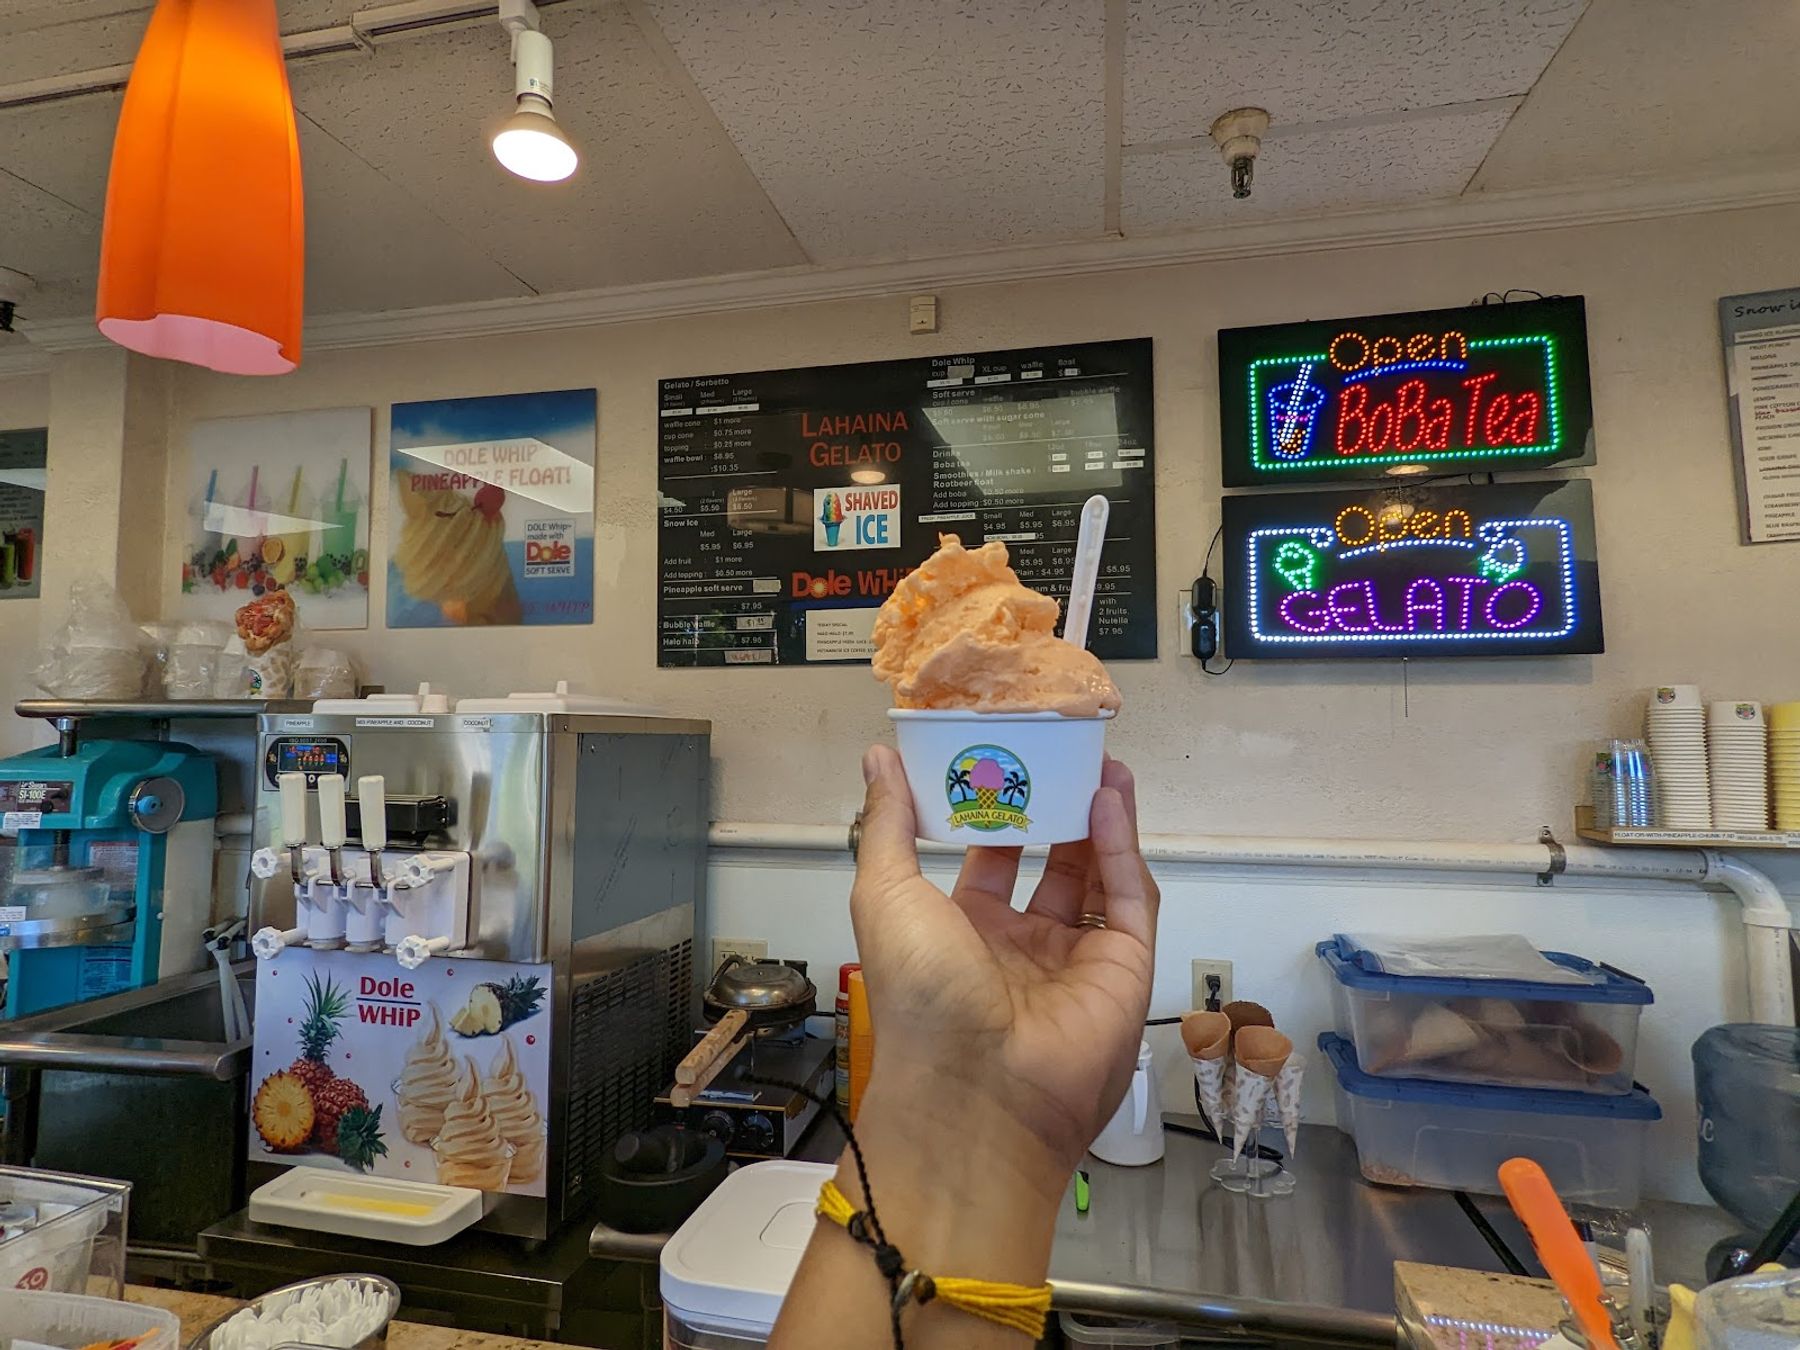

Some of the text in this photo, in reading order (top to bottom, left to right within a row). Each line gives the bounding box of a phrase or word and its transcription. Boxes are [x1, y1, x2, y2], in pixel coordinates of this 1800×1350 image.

[1734, 304, 1785, 318] Snow
[1329, 331, 1467, 376] Open
[932, 356, 976, 368] Dole Whip
[664, 381, 690, 390] Gelato
[695, 378, 730, 387] Sorbetto
[932, 389, 976, 399] Soft serve
[1462, 373, 1539, 446] Tea
[801, 410, 909, 438] LAHAINA
[444, 444, 538, 466] DOLE WHIP
[810, 441, 902, 468] GELATO
[509, 466, 572, 486] FLOAT!
[933, 480, 973, 488] Rootbeer
[844, 490, 899, 512] SHAVED
[1052, 509, 1072, 517] Large
[528, 523, 546, 532] DOLE
[664, 520, 684, 528] Snow
[856, 514, 889, 545] ICE
[984, 523, 1006, 531] $4.95
[1020, 520, 1044, 529] $5.95
[1335, 505, 1472, 552] Open
[526, 540, 571, 562] Dole
[1052, 546, 1072, 555] Large
[526, 566, 570, 575] SOFT SERVE
[1106, 565, 1131, 573] $5.95
[664, 586, 702, 594] Pineapple
[791, 568, 852, 598] Dole
[1279, 578, 1541, 633] GELATO
[18, 790, 46, 800] SI-100E
[954, 811, 1024, 825] LAHAINA GELATO
[360, 976, 414, 999] Dole
[358, 1004, 421, 1028] WHiP
